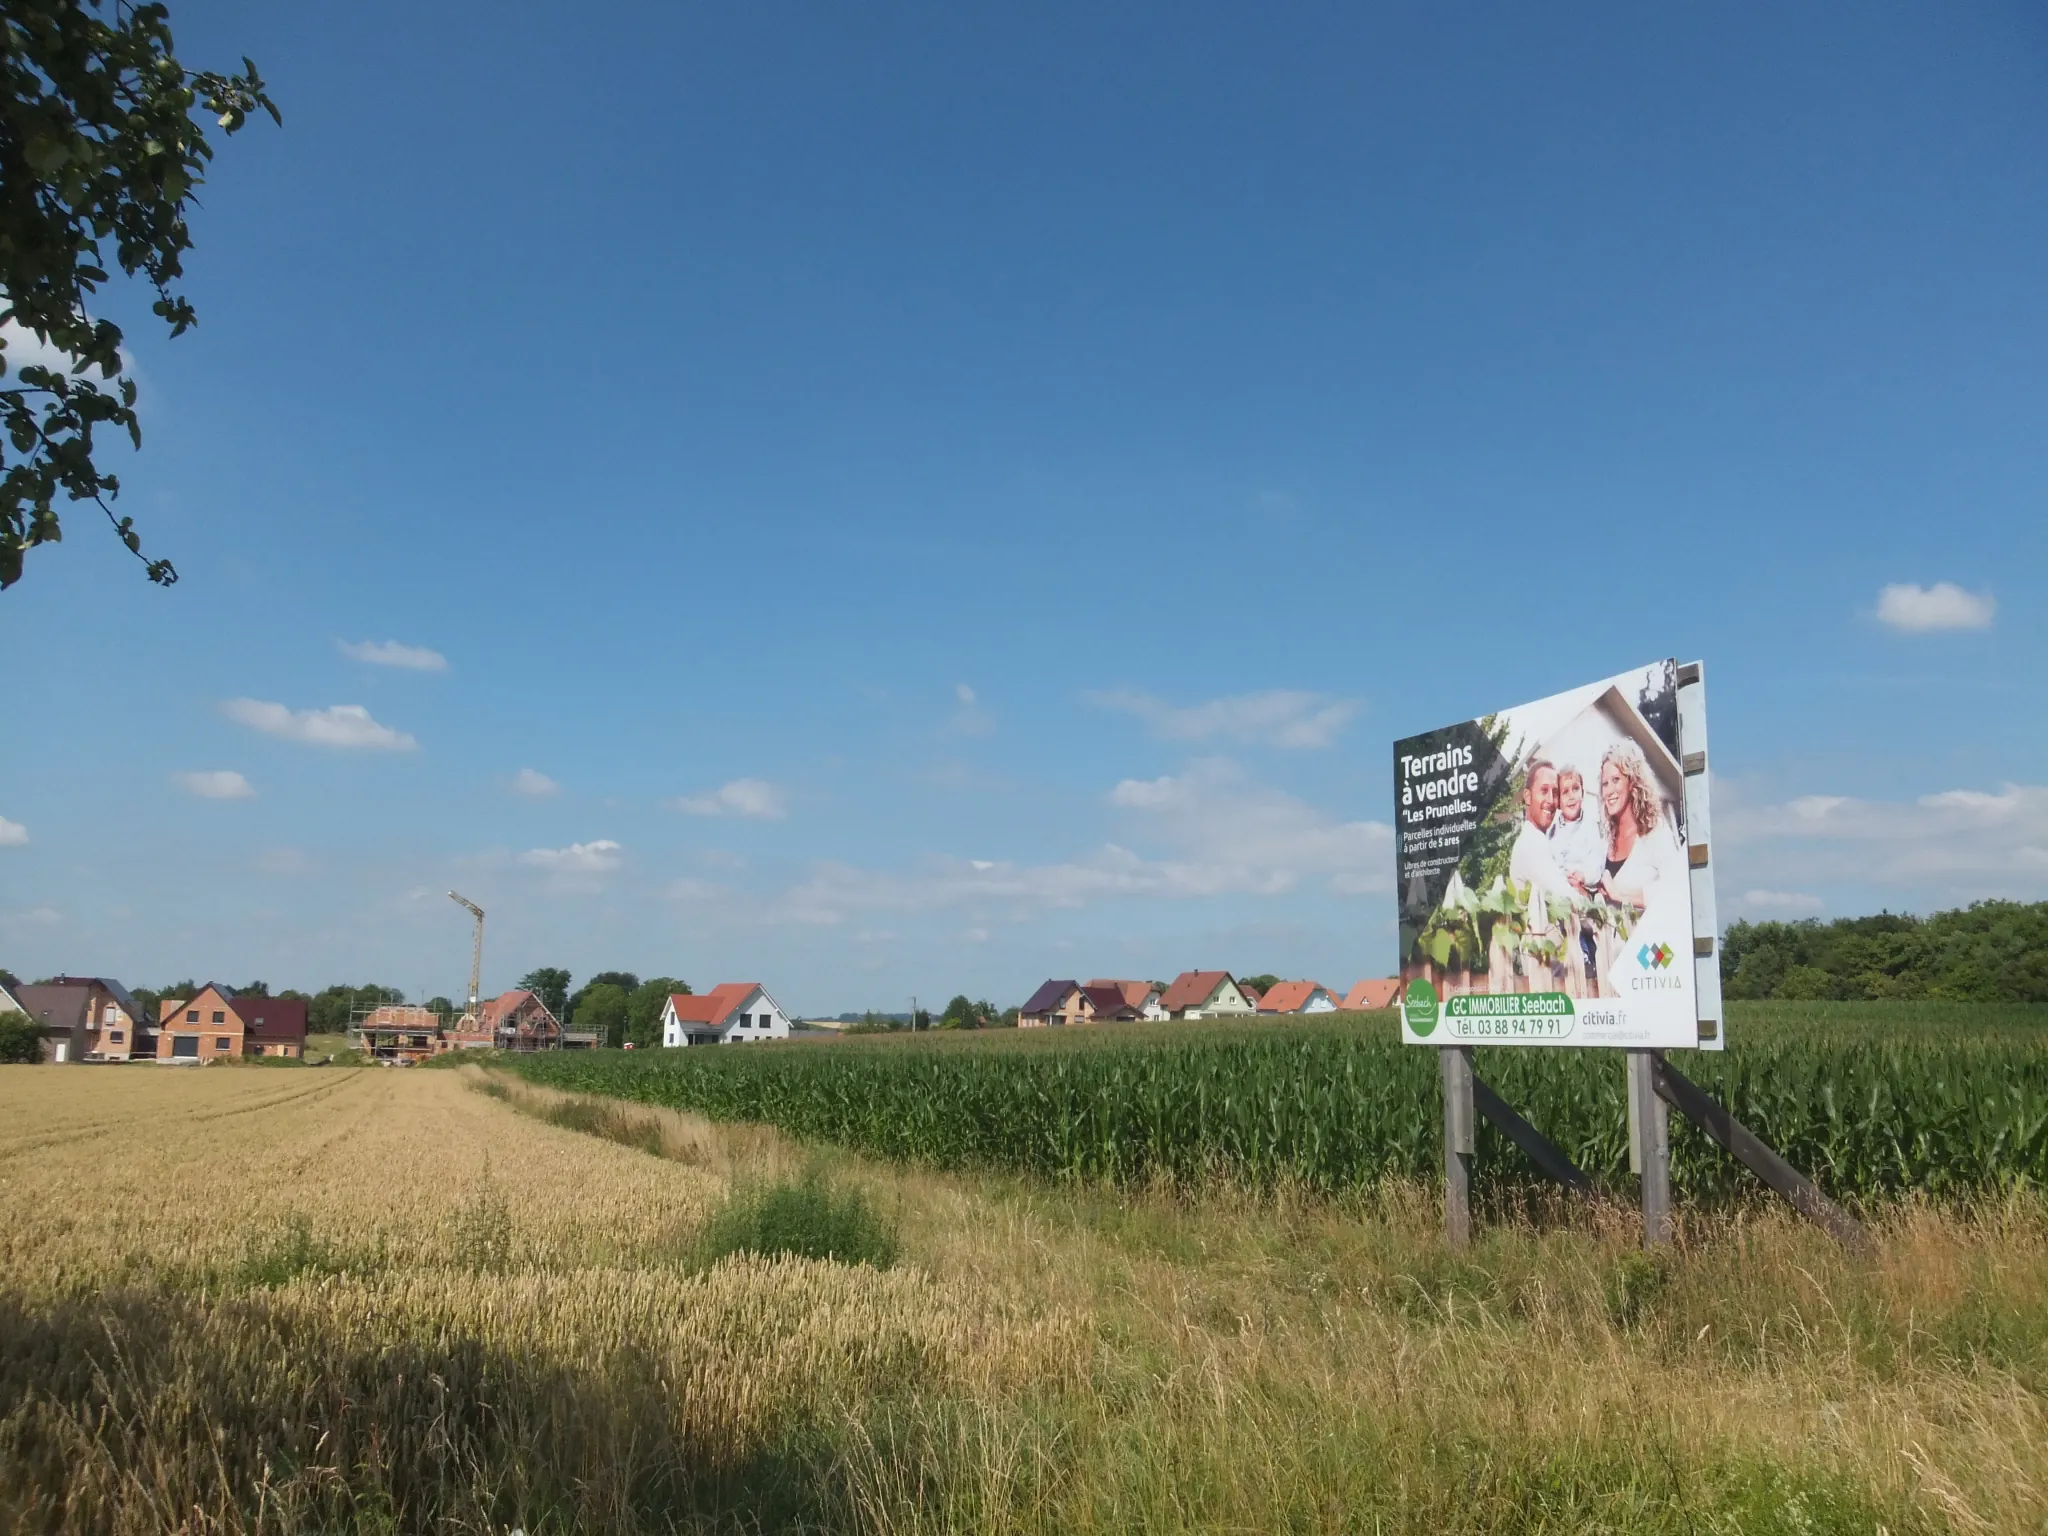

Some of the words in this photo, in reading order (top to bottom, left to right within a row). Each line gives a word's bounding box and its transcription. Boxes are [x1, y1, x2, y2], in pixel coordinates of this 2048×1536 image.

[1401, 743, 1472, 778] Terrains
[1402, 781, 1413, 805] à
[1416, 767, 1478, 802] vendre
[1403, 827, 1433, 842] Parcelles
[1433, 820, 1477, 838] individuelles
[1403, 844, 1409, 853] à
[1409, 839, 1428, 854] partir
[1428, 838, 1437, 848] de
[1438, 838, 1443, 847] 5
[1443, 835, 1460, 846] ares
[1404, 862, 1420, 870] Libres
[1427, 856, 1459, 866] constructeur
[1631, 976, 1682, 990] CITIVIA
[1452, 998, 1467, 1015] GC
[1469, 998, 1520, 1015] IMMOBILIER
[1522, 995, 1565, 1014] Seebach
[1456, 1018, 1475, 1035] Tél.
[1478, 1020, 1491, 1035] 03
[1495, 1020, 1508, 1035] 88
[1512, 1019, 1525, 1034] 94
[1530, 1019, 1543, 1034] 79
[1548, 1019, 1561, 1034] 91
[1582, 1010, 1628, 1025] citivia.fr
